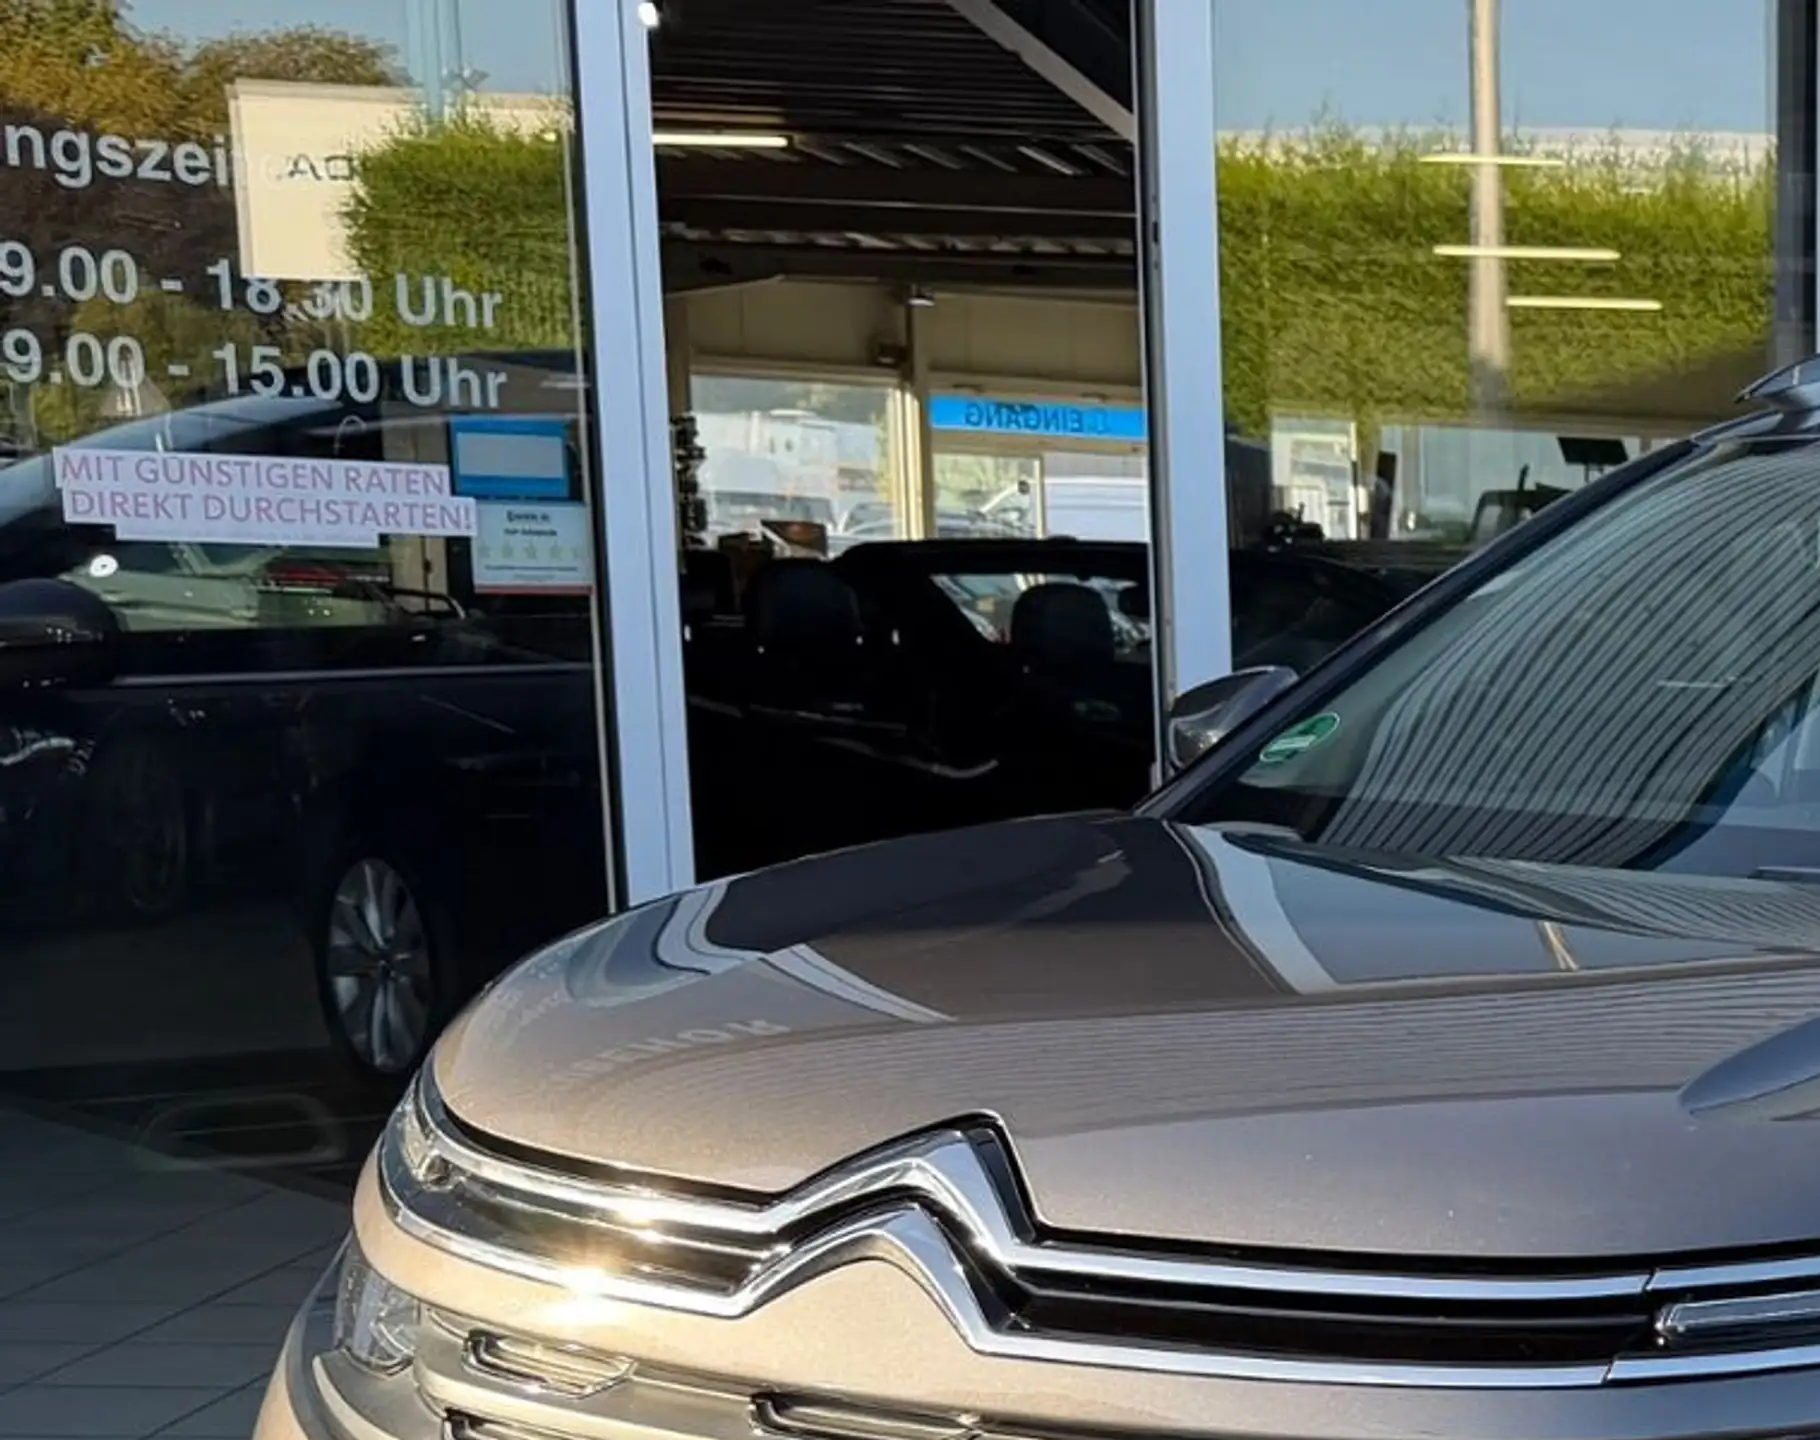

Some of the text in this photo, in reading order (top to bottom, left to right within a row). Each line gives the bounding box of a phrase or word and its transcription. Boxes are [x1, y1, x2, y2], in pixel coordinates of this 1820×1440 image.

[4, 123, 229, 189] ngszei
[396, 272, 503, 328] Uhr
[212, 342, 380, 403] 15.00
[401, 354, 508, 408] Uhr
[62, 455, 123, 482] MIT
[344, 465, 444, 496] RATEN
[72, 489, 472, 531] DIREKT DURCHSTARTEN!
